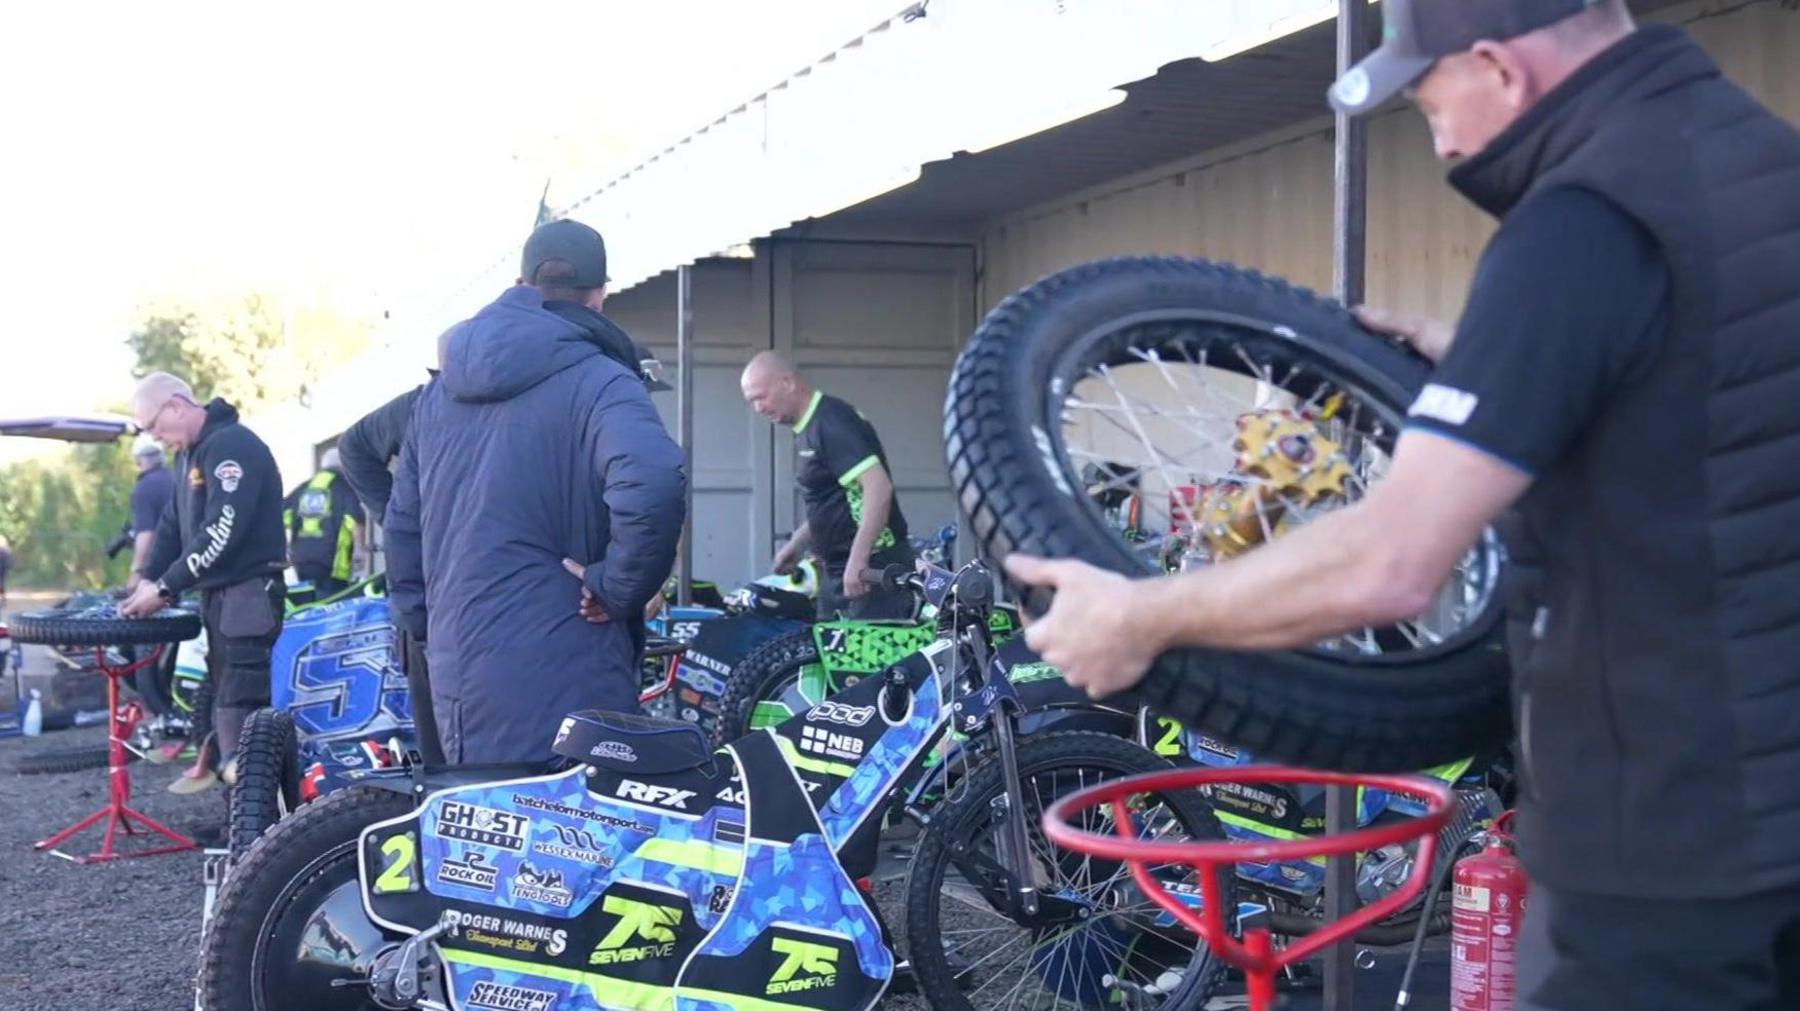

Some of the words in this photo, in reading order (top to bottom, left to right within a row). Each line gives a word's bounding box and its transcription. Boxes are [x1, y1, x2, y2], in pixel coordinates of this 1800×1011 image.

[187, 504, 236, 578] Pauline
[686, 649, 731, 677] WARNER
[807, 702, 876, 727] pod
[828, 732, 864, 754] NEB
[1154, 716, 1183, 756] 2
[616, 779, 697, 809] RFX
[375, 834, 415, 891] 2
[441, 865, 475, 880] ROCK
[475, 872, 495, 884] OIL
[443, 909, 501, 938] ROGER
[503, 919, 568, 956] WARNES
[596, 895, 683, 950] 75
[769, 936, 839, 983] 75
[469, 983, 555, 1003] SPEEDWAY
